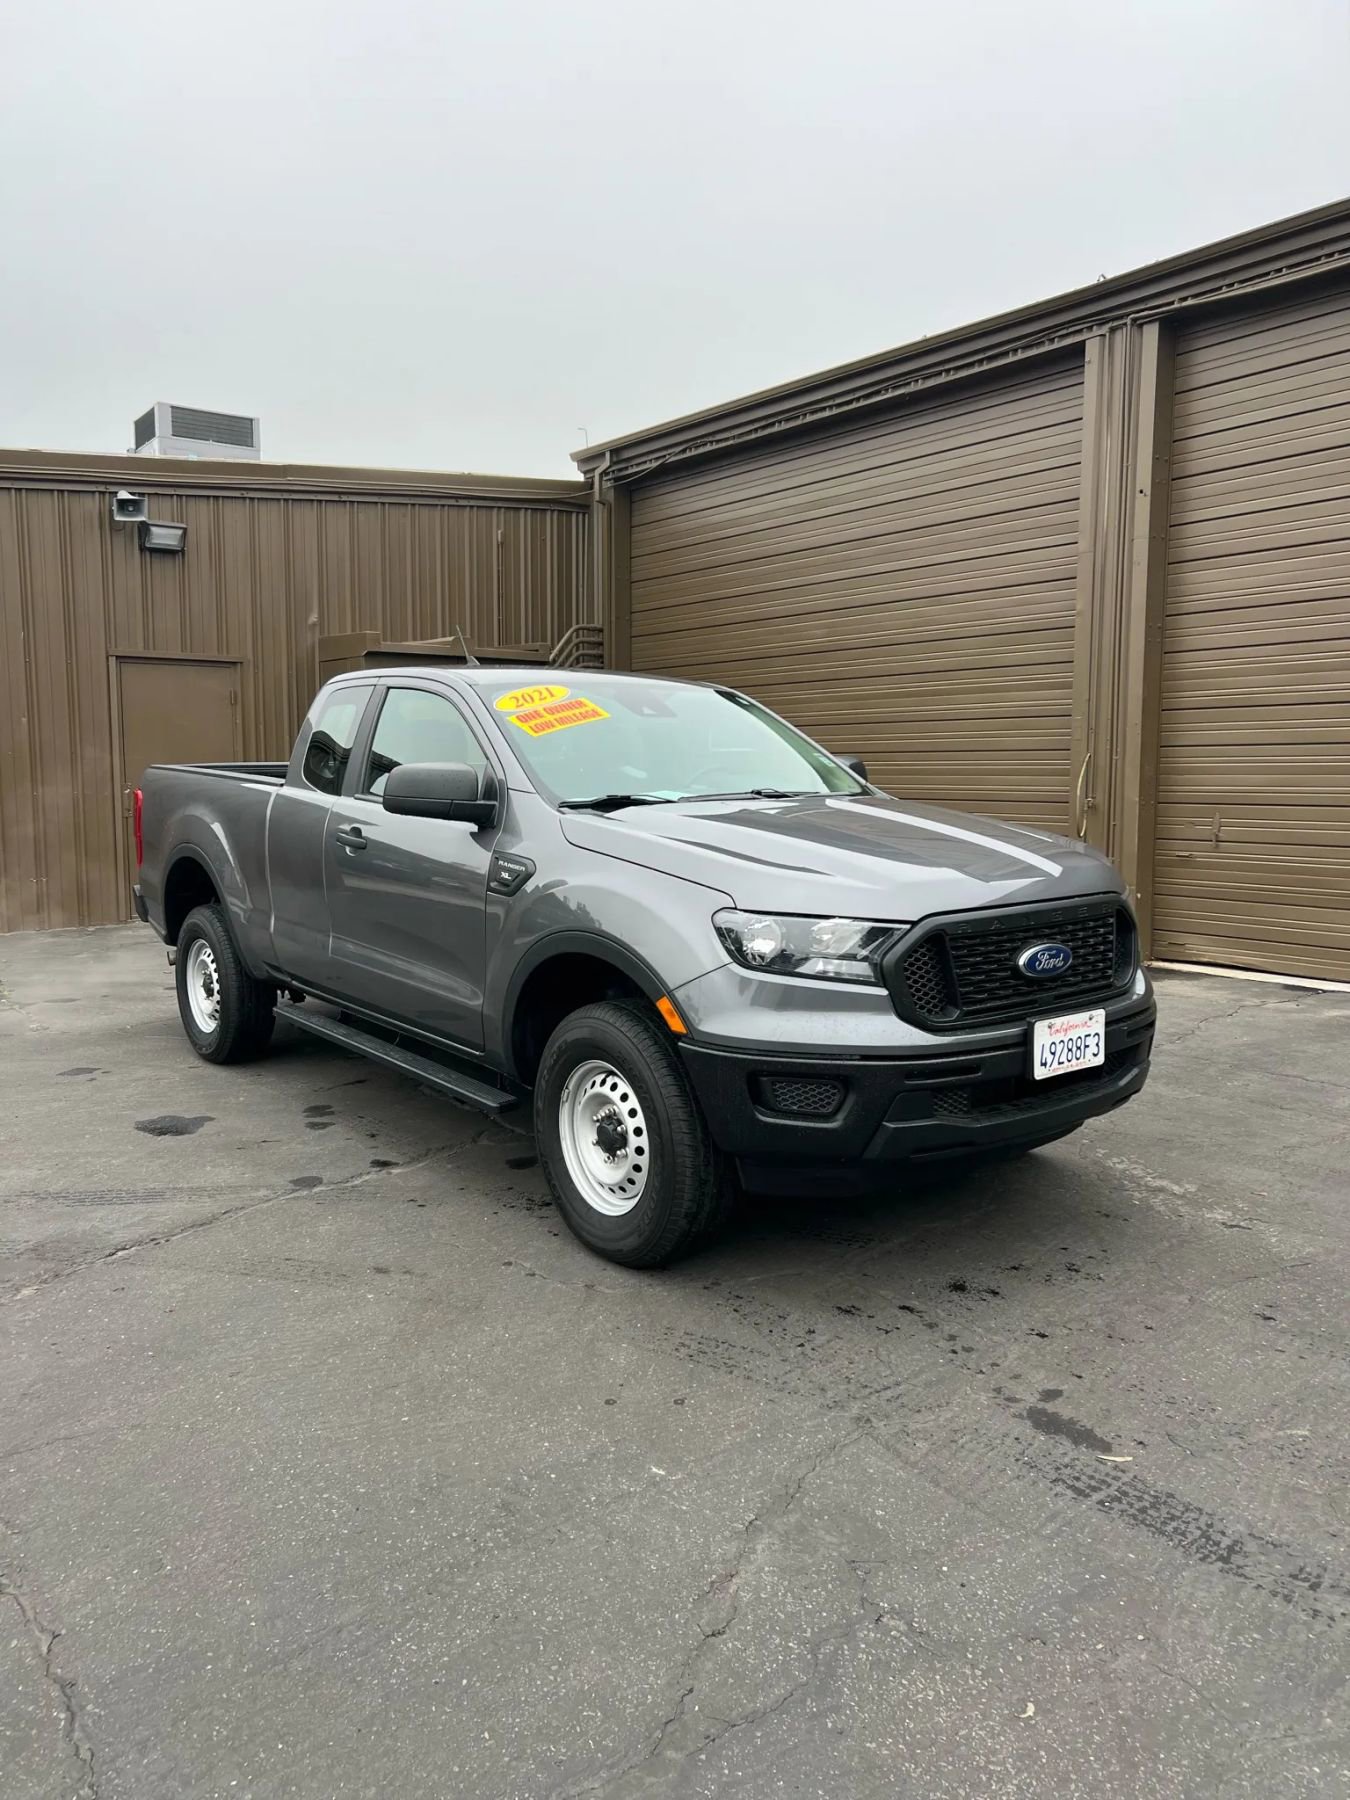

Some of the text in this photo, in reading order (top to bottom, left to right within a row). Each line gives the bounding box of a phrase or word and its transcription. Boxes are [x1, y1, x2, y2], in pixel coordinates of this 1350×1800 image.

[508, 687, 556, 708] 2021
[516, 700, 588, 724] ONE OWNER
[528, 708, 602, 734] LOW MILEAGE
[498, 860, 526, 871] RANGER
[500, 871, 512, 880] XL
[1035, 949, 1064, 971] Ford
[1049, 1020, 1093, 1037] California
[1040, 1031, 1101, 1069] 49288F3
